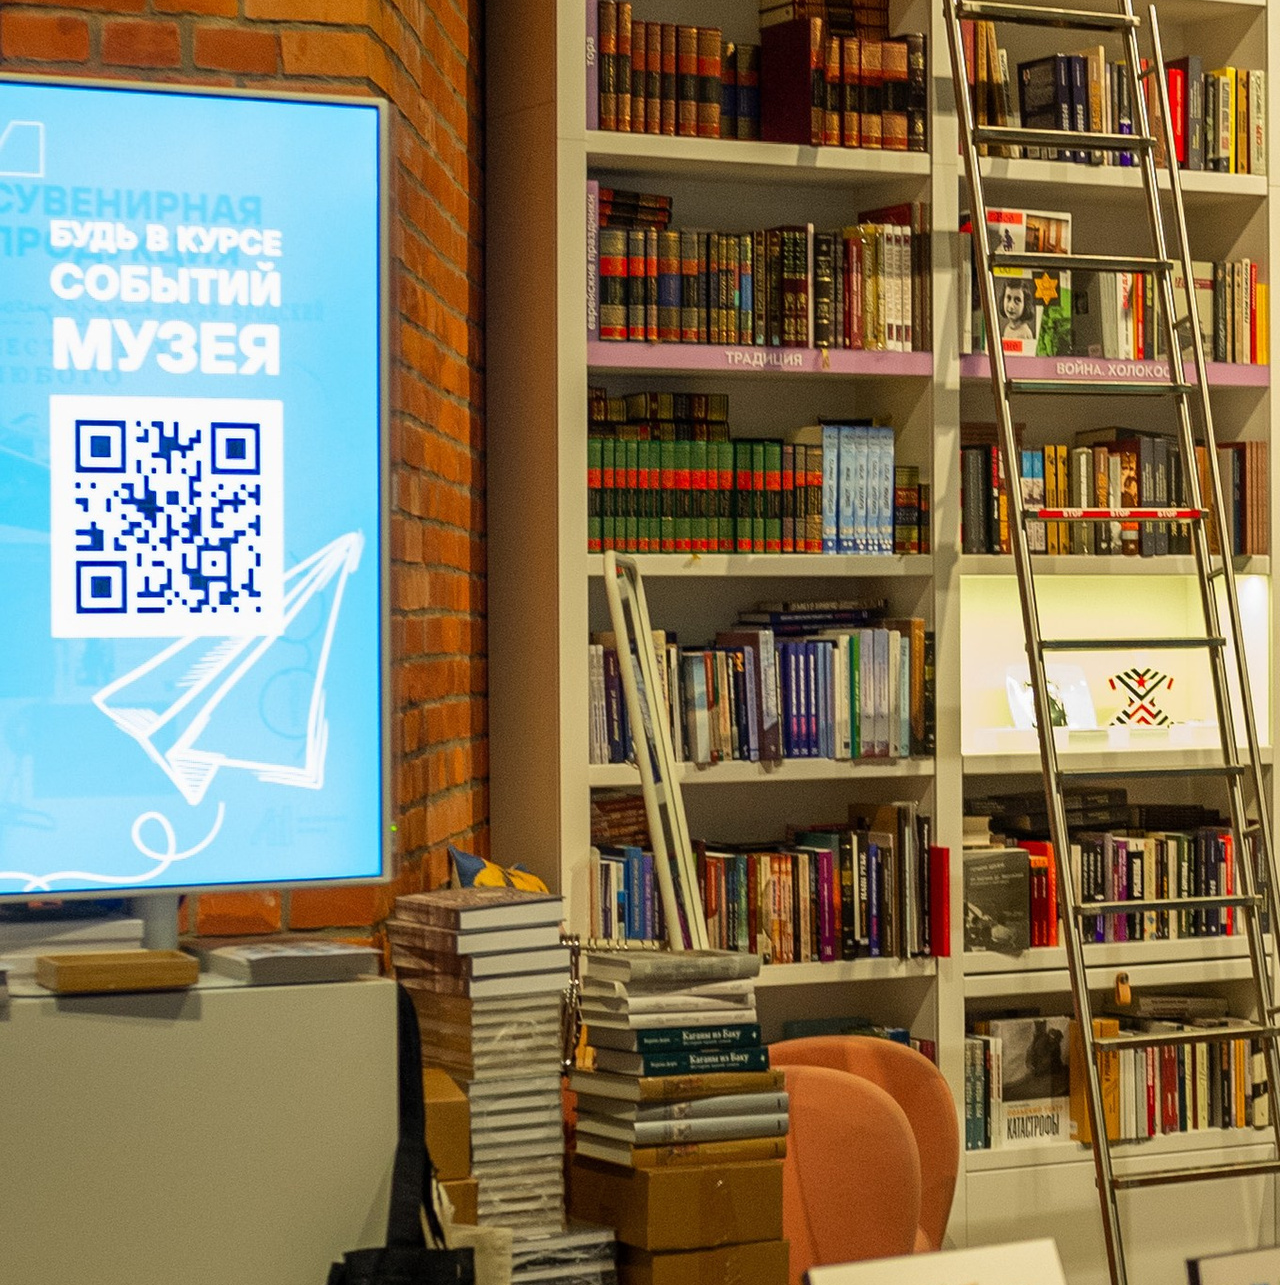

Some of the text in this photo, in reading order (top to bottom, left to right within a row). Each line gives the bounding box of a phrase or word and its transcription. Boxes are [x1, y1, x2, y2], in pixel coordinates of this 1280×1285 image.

[50, 219, 283, 258] БУДЬ В КУРСЕ
[50, 261, 282, 308] СОБЫТИЙ
[53, 317, 281, 376] МУЗЕЯ
[725, 350, 803, 366] ТРАДИЦИЯ
[1057, 359, 1170, 379] ВОЙНА. ХОЛОКОС
[1062, 510, 1084, 518] STOP
[1110, 510, 1131, 518] STOP
[1157, 510, 1178, 518] STOP
[1007, 1113, 1060, 1139] КАТАСТРОФЫ
